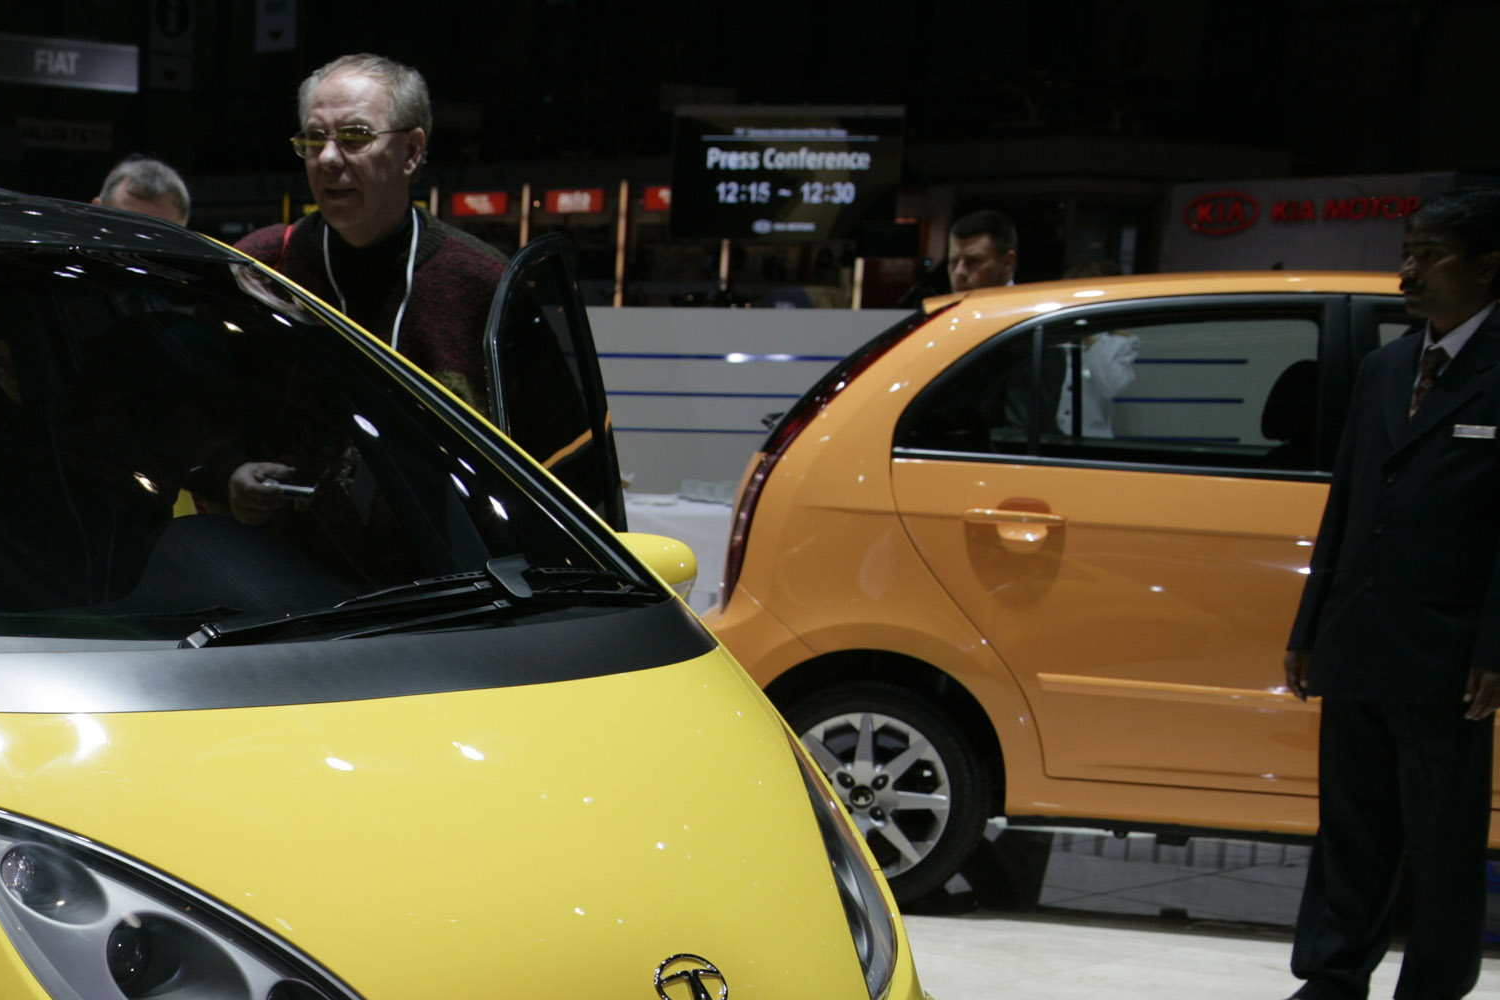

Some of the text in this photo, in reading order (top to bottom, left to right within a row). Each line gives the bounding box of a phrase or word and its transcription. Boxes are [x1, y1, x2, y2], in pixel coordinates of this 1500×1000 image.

[33, 48, 80, 76] FIAT
[706, 147, 872, 170] Press Conference
[716, 181, 772, 204] 12:15
[800, 181, 856, 204] 12:30
[1196, 200, 1245, 225] KIA
[1271, 200, 1316, 223] KIA
